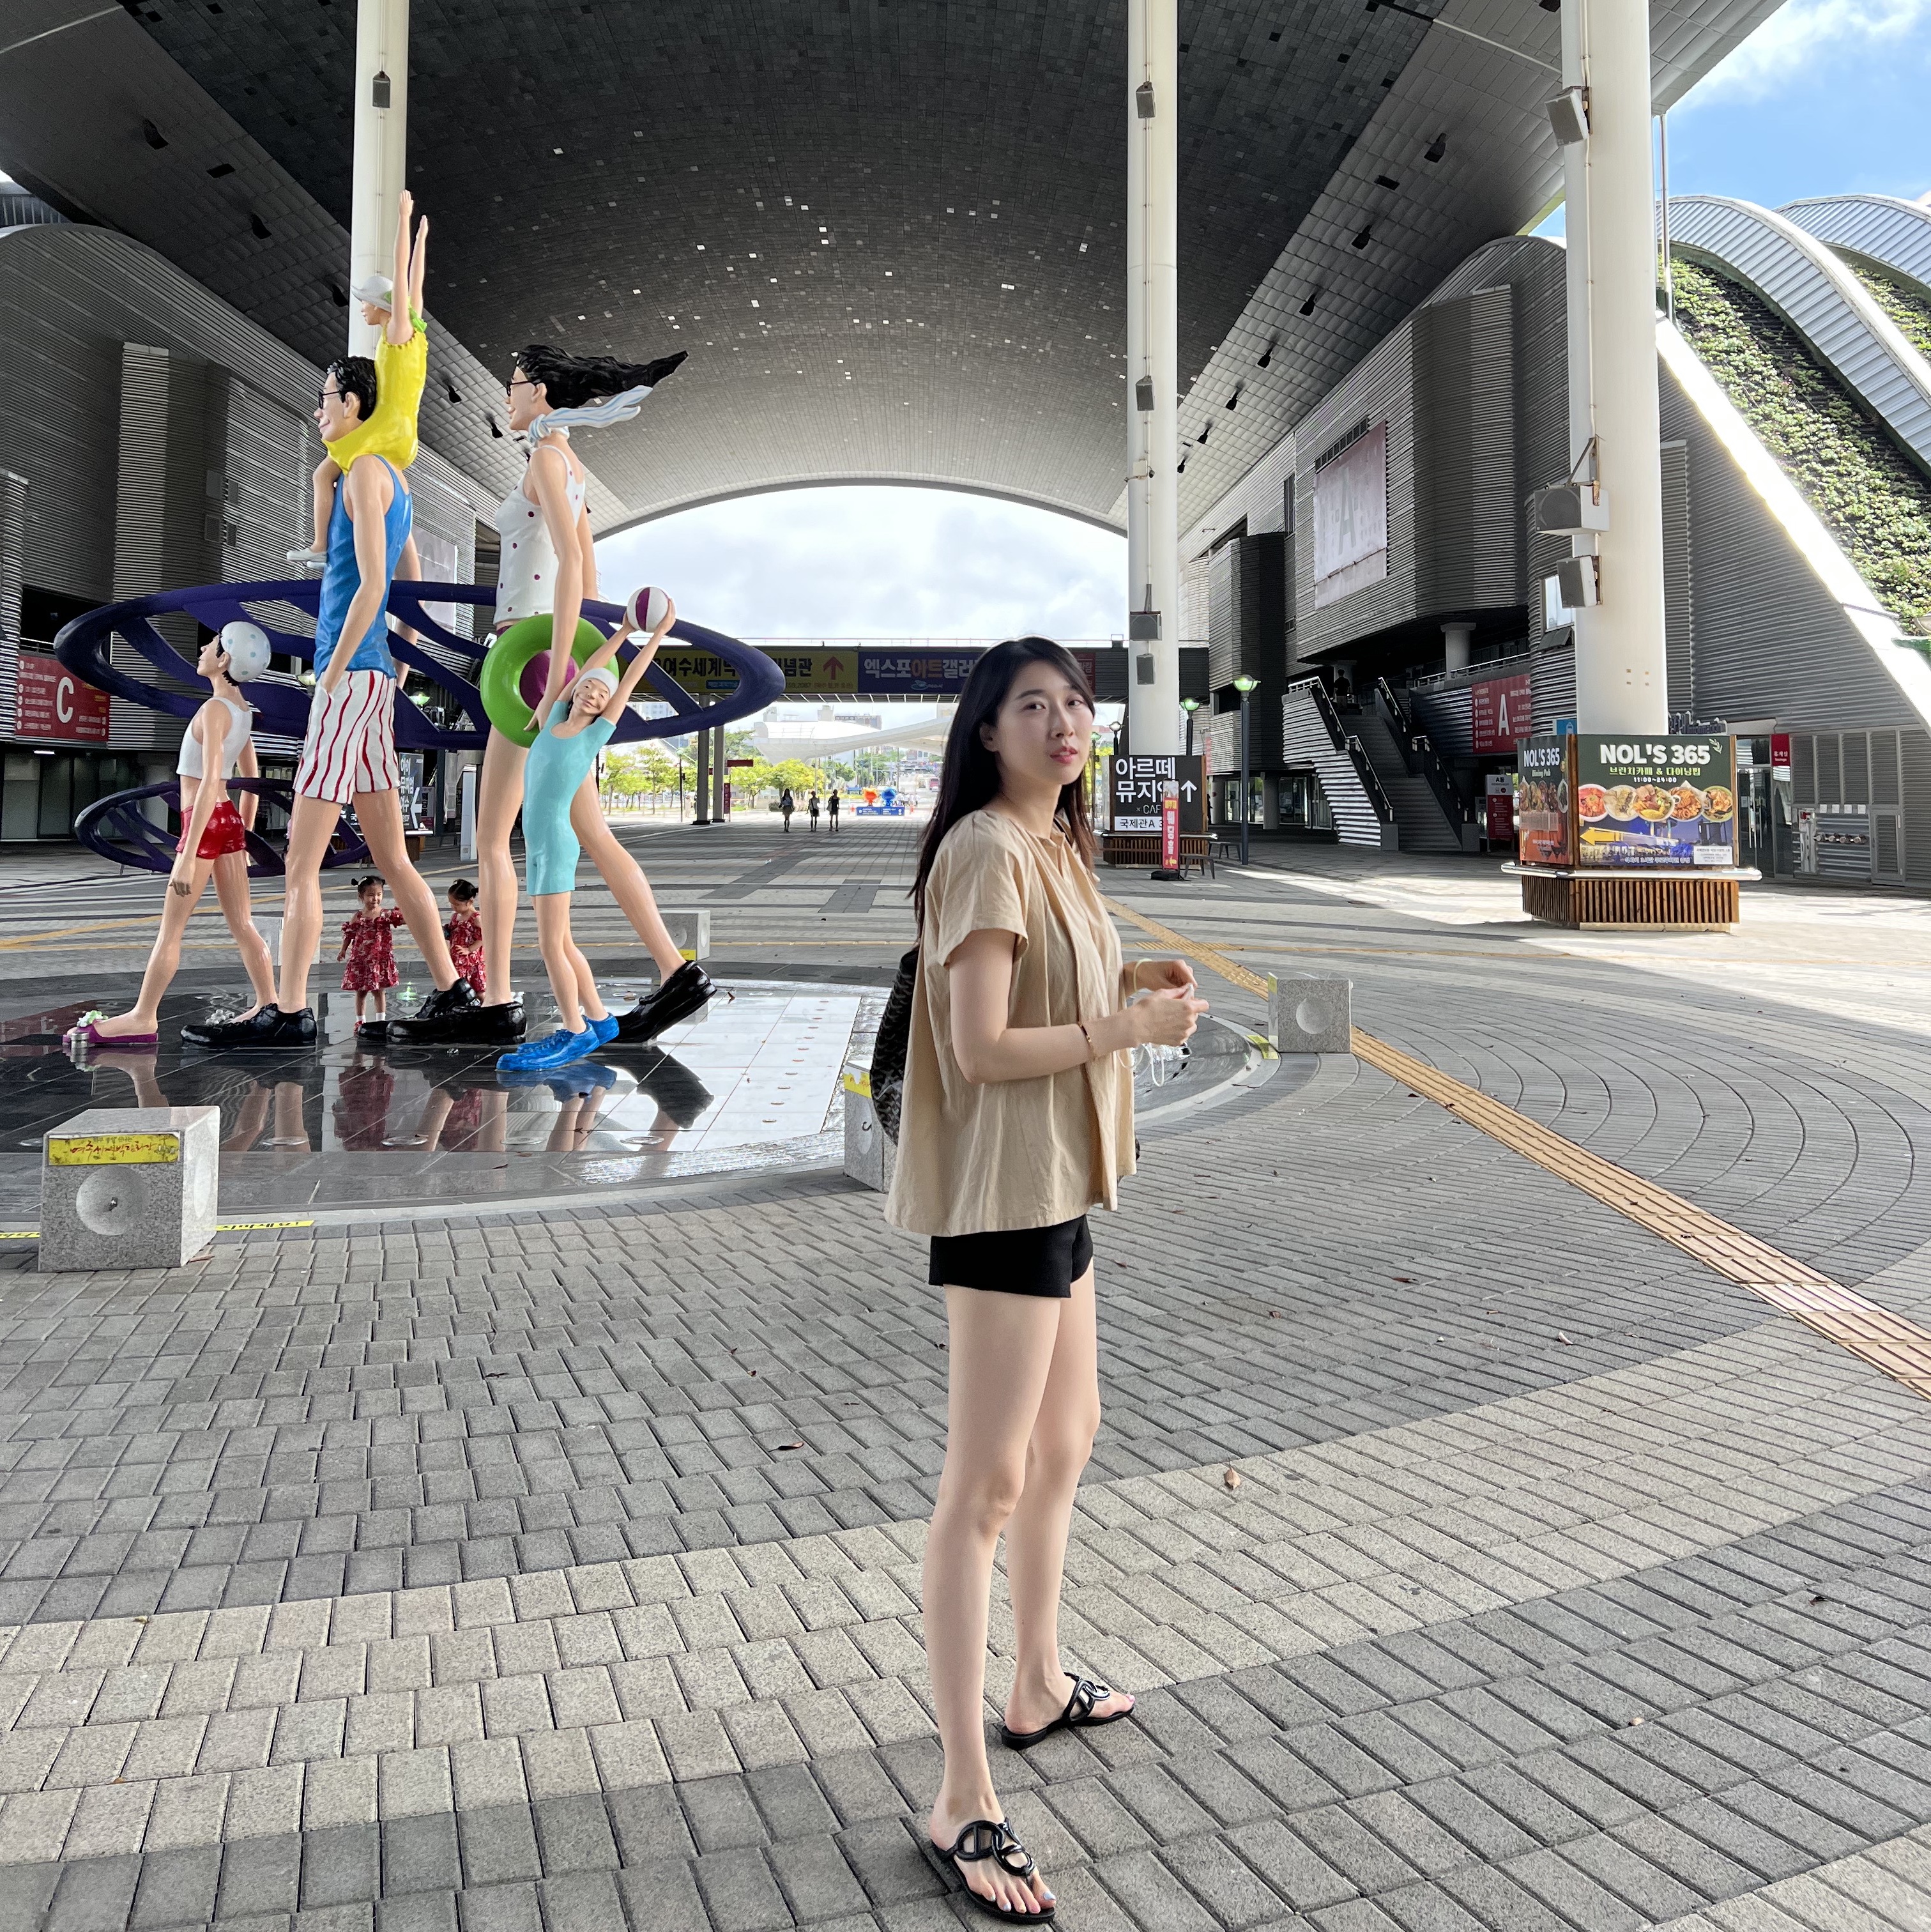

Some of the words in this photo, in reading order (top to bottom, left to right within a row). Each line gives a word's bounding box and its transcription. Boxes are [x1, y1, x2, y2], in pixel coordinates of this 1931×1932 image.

[1338, 466, 1357, 555] A
[864, 659, 977, 678] 엑스포아트갤러
[57, 677, 74, 723] C
[1498, 694, 1510, 737] A
[1523, 748, 1546, 767] NOL'S
[1546, 747, 1560, 766] 365
[1600, 744, 1668, 764] NOL'S
[1671, 744, 1711, 765] 365
[1115, 757, 1175, 779] 아르떼
[1609, 767, 1653, 776] 브런치카페
[1656, 767, 1663, 776] &
